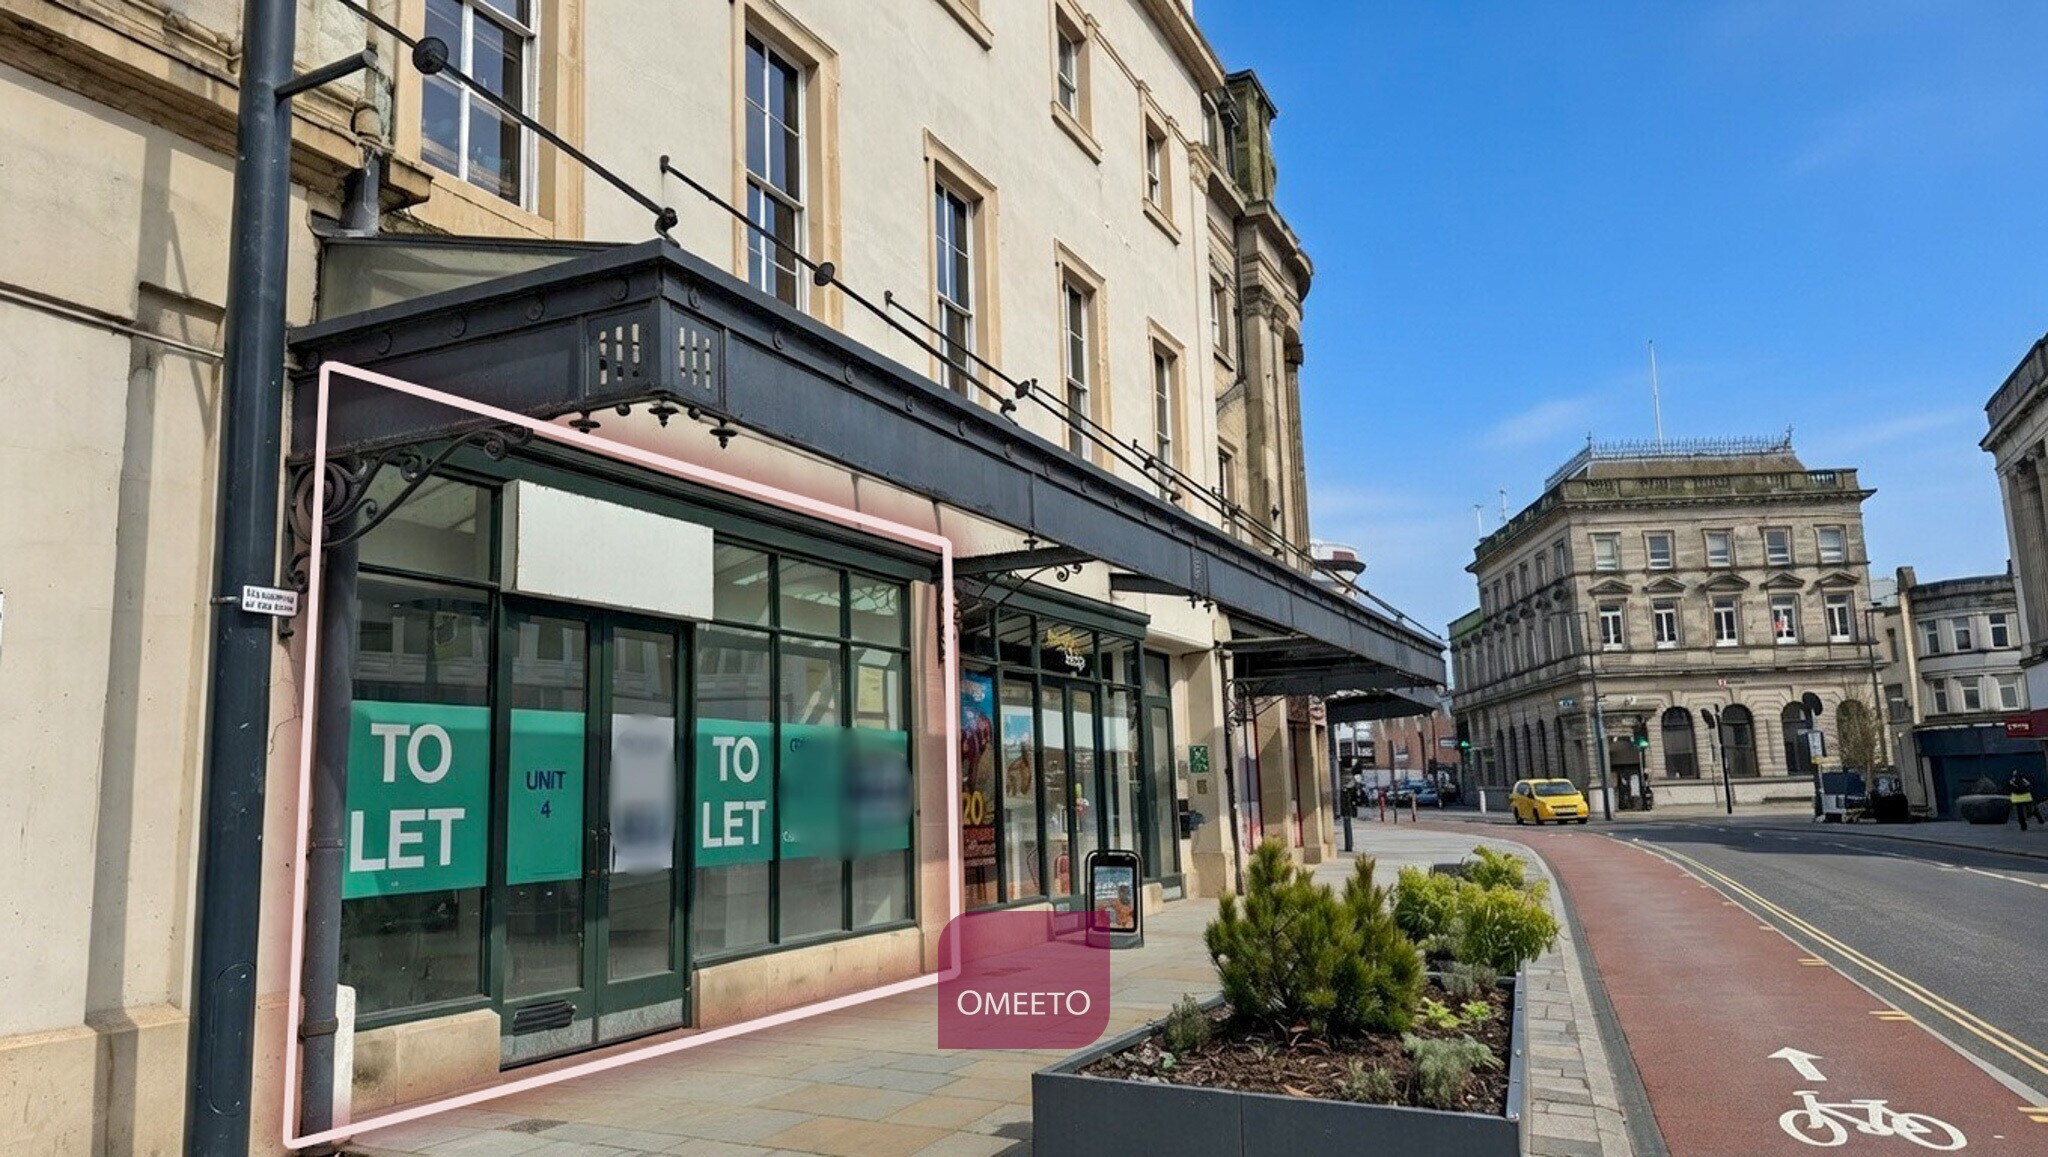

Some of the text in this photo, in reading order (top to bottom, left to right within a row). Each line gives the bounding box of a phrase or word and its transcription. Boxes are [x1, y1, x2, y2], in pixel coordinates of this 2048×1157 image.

[371, 723, 452, 784] TO
[713, 736, 759, 783] TO
[526, 770, 567, 790] UNIT
[540, 800, 552, 818] 4
[702, 800, 767, 848] LET
[350, 808, 465, 873] LET
